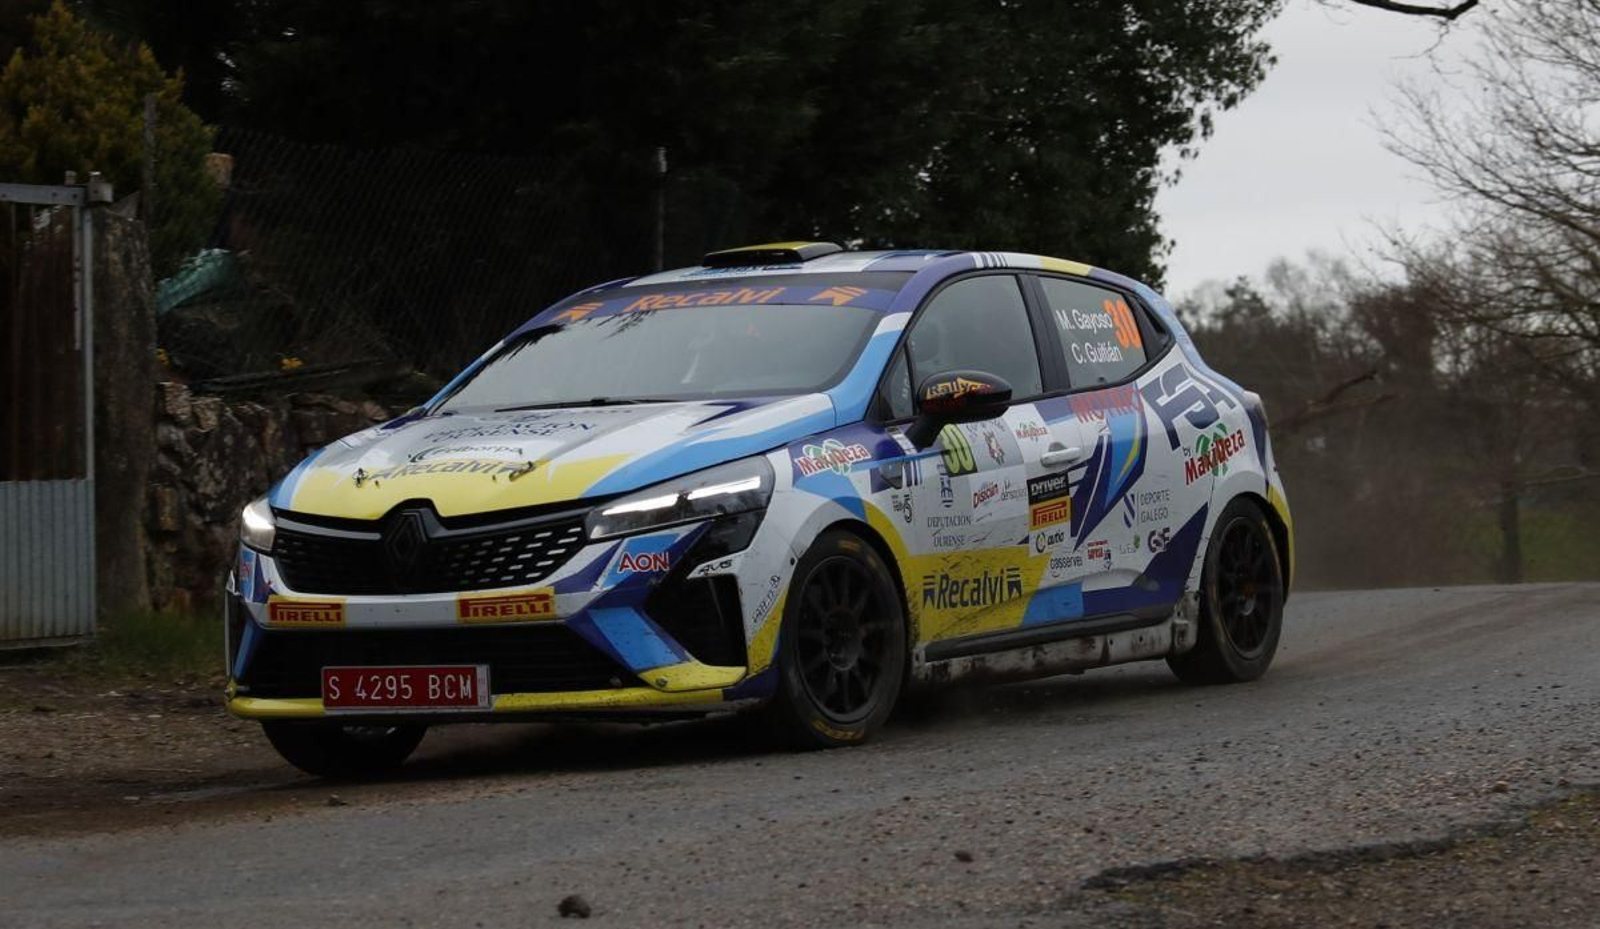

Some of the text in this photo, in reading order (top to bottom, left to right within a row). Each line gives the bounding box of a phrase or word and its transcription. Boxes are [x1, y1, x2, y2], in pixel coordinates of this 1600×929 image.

[624, 287, 786, 313] Recalvi
[1056, 309, 1113, 333] M. Gayoso
[1103, 298, 1143, 349] 30
[1071, 343, 1085, 364] C.
[1140, 489, 1170, 503] DEPORTE
[1033, 500, 1067, 527] PIRELLI
[1140, 507, 1169, 523] GALEGO
[618, 552, 670, 573] AON
[937, 568, 1004, 610] Recalvi
[269, 601, 342, 623] PIRELLI
[459, 593, 550, 619] PIRELLI
[328, 675, 341, 700] S
[355, 674, 413, 700] 4295
[428, 674, 473, 700] BCM
